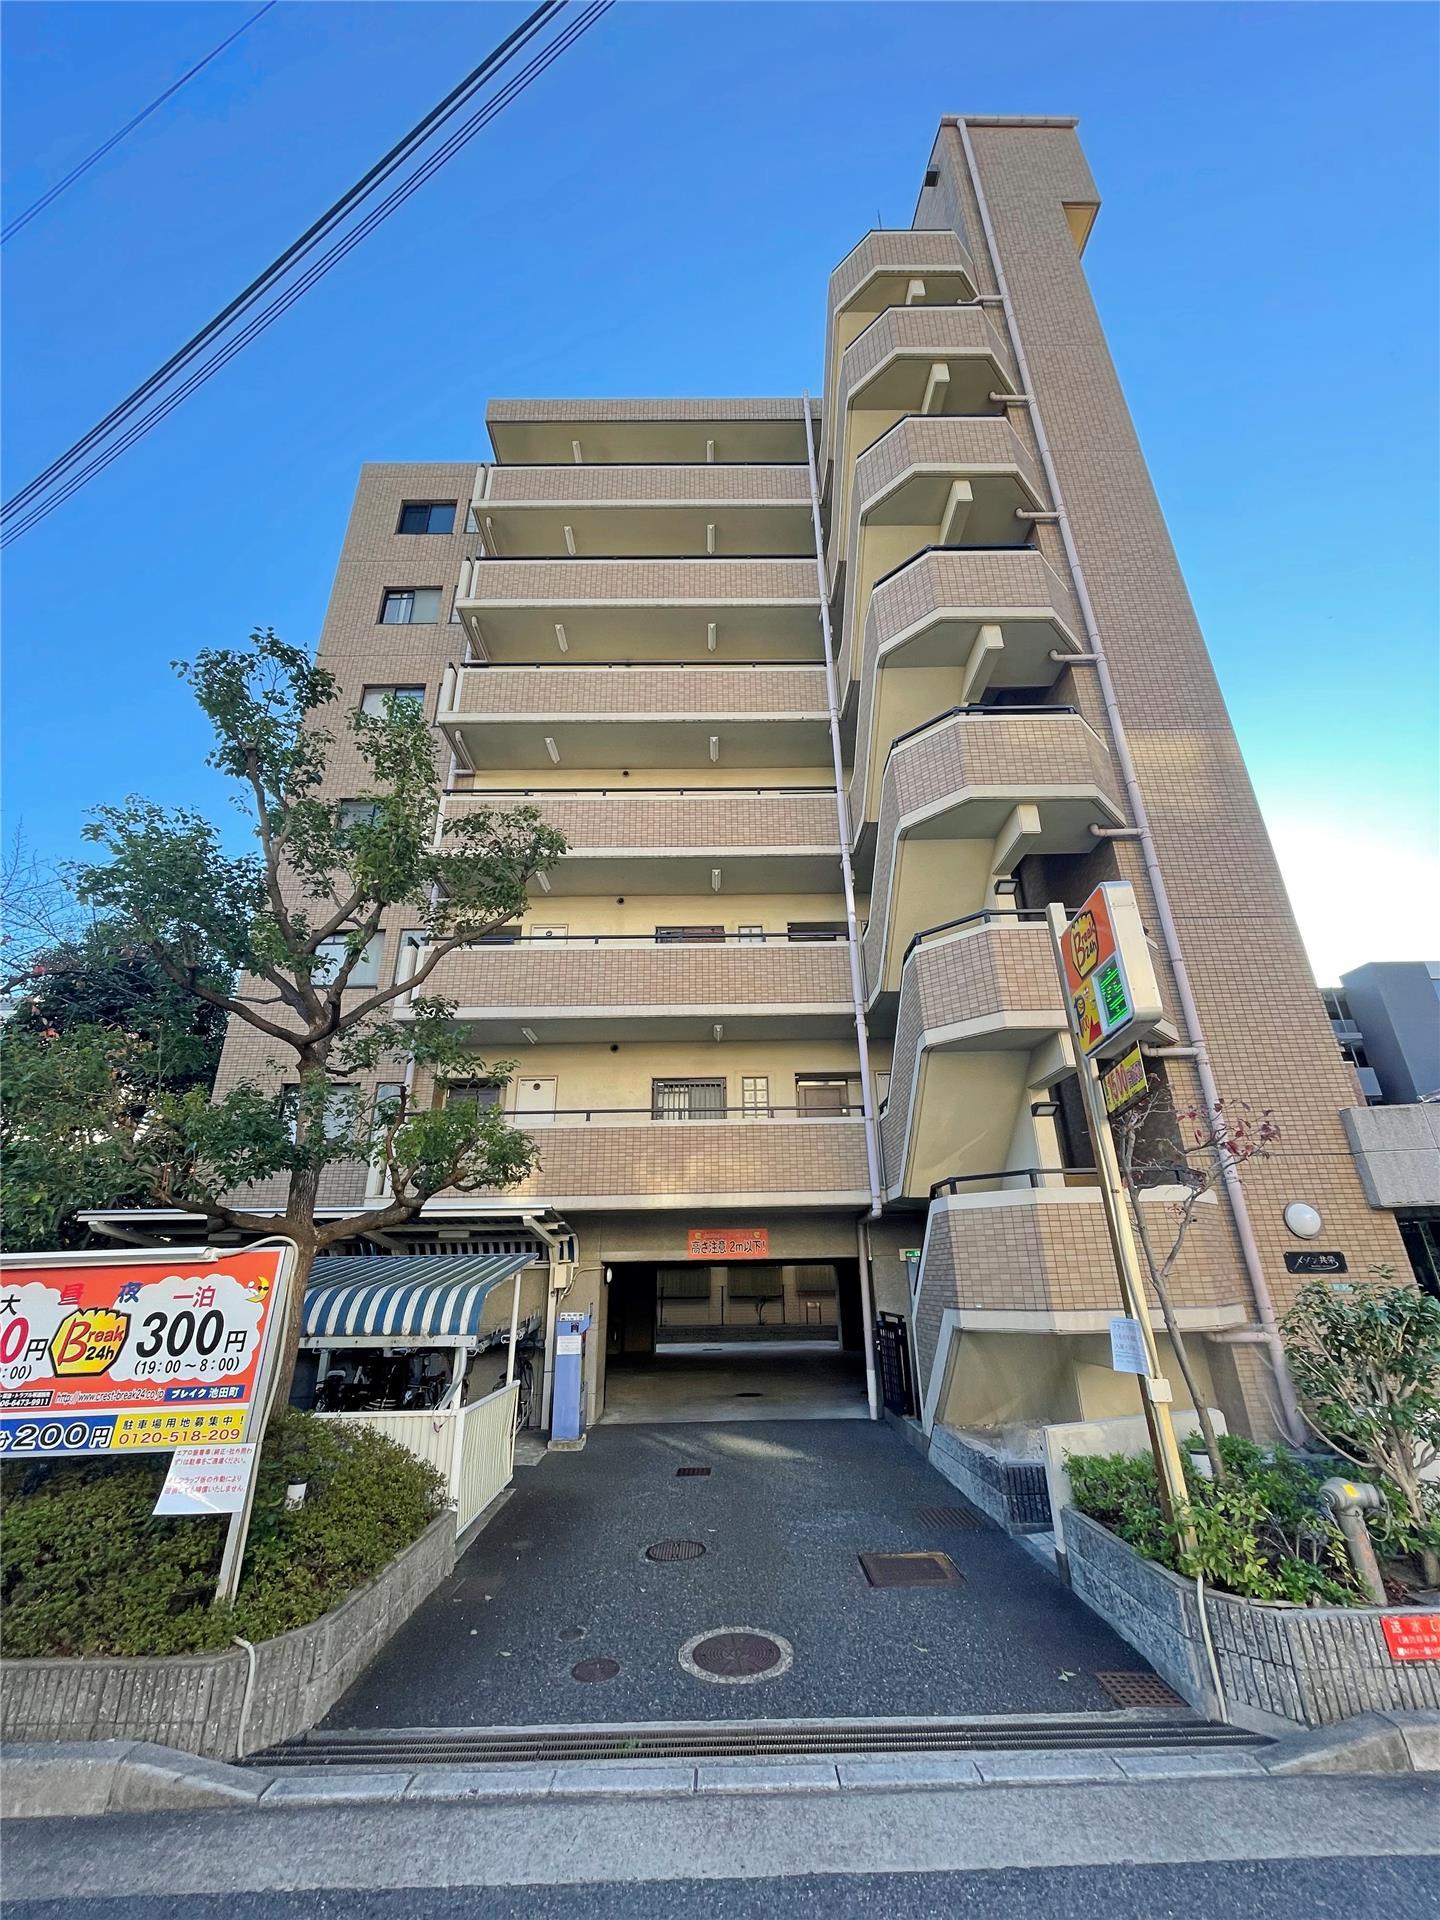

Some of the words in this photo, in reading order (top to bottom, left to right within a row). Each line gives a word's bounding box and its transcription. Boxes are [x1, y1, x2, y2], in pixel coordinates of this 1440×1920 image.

[691, 1240, 726, 1254] 高さ注意
[118, 1282, 143, 1303] 夜
[172, 1285, 216, 1308] 一泊
[57, 1318, 125, 1366] Break
[135, 1309, 248, 1358] 300円
[85, 1345, 115, 1360] 24h
[171, 1388, 207, 1399] ブレイク
[208, 1386, 240, 1398] 池田町
[119, 1428, 240, 1444] 0120-518-209
